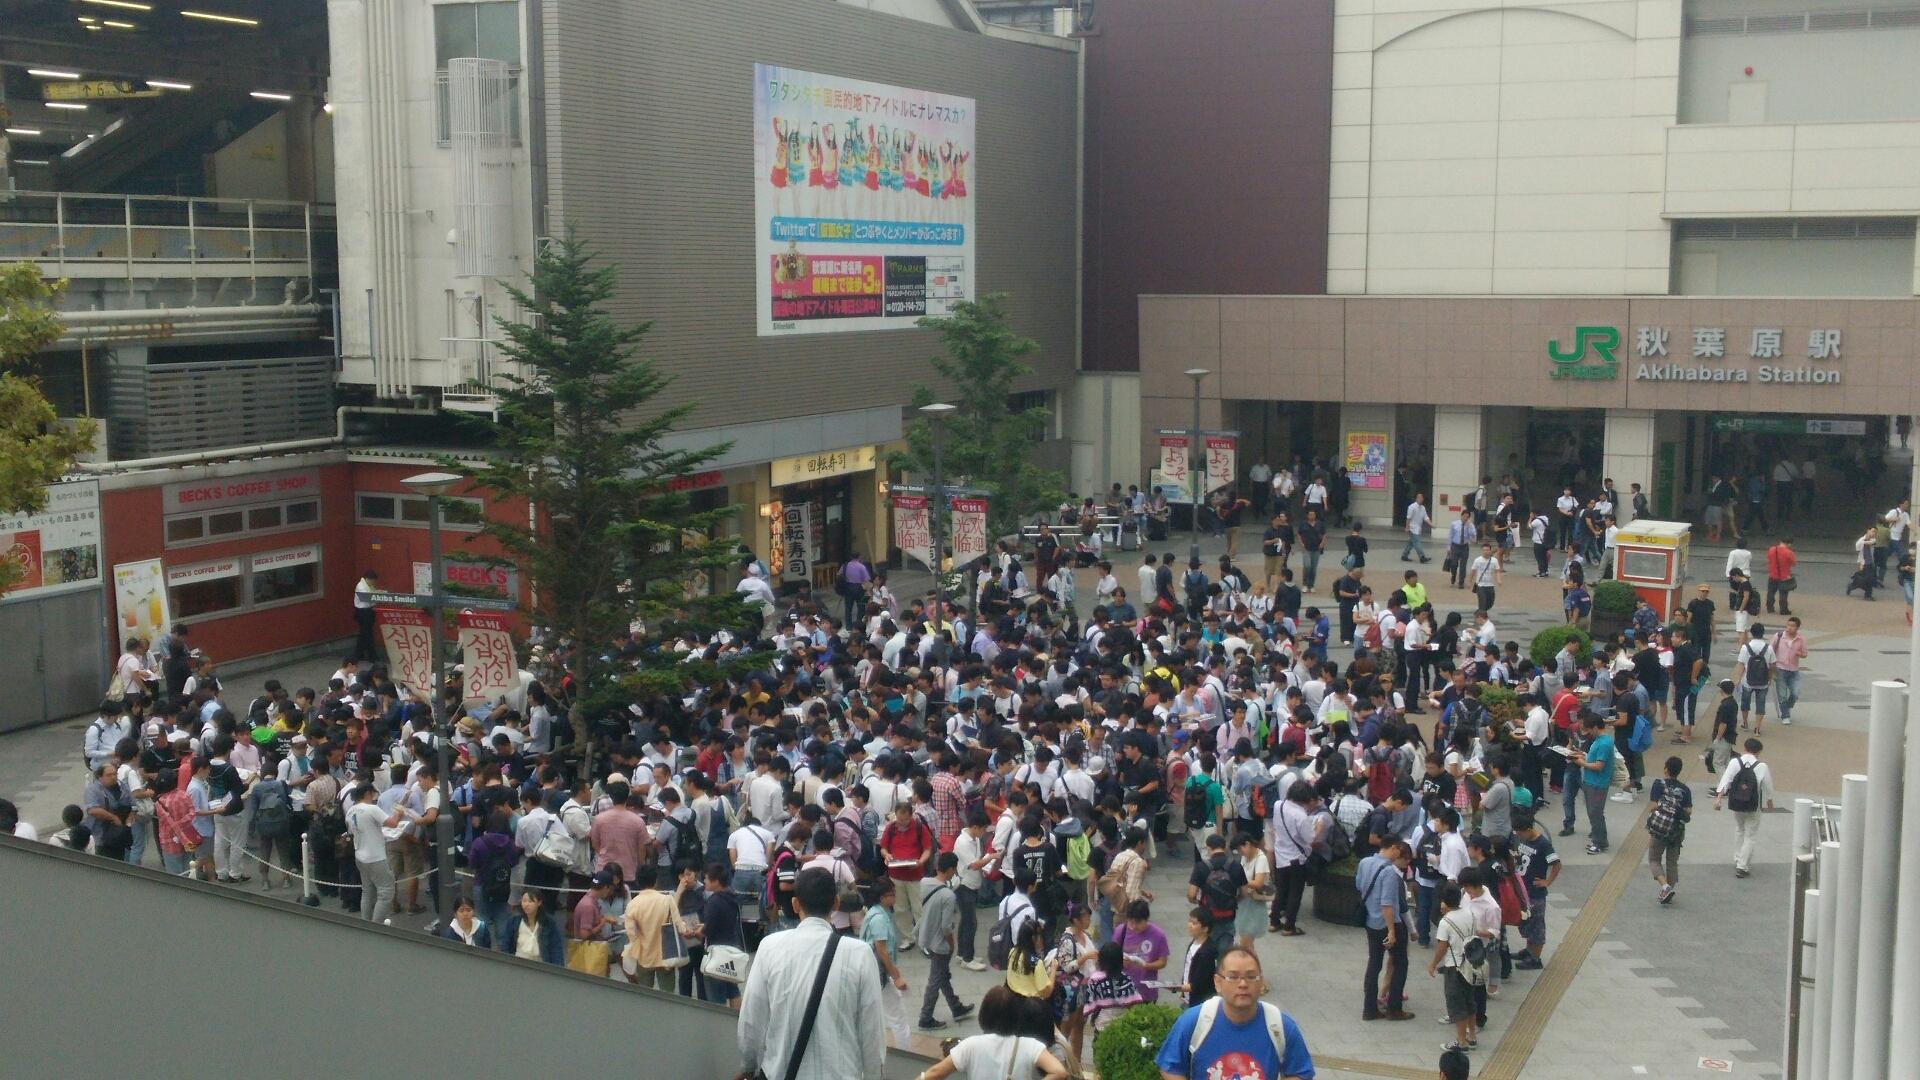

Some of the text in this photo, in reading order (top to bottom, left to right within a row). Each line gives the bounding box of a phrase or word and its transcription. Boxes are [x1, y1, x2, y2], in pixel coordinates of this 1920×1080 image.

[1548, 326, 1620, 362] JR
[1636, 327, 1841, 359] 秋葉原駅
[1636, 364, 1841, 383] Akihabara Station
[807, 453, 846, 474] 回転寿司
[179, 476, 308, 503] BECK'S COFFEE SHOP
[784, 509, 807, 576] 回転寿司
[171, 563, 233, 579] BECK'S COFFEE SHOP
[447, 566, 508, 585] BECK'S
[371, 594, 393, 602] Akiba
[469, 619, 501, 630] ICHI
